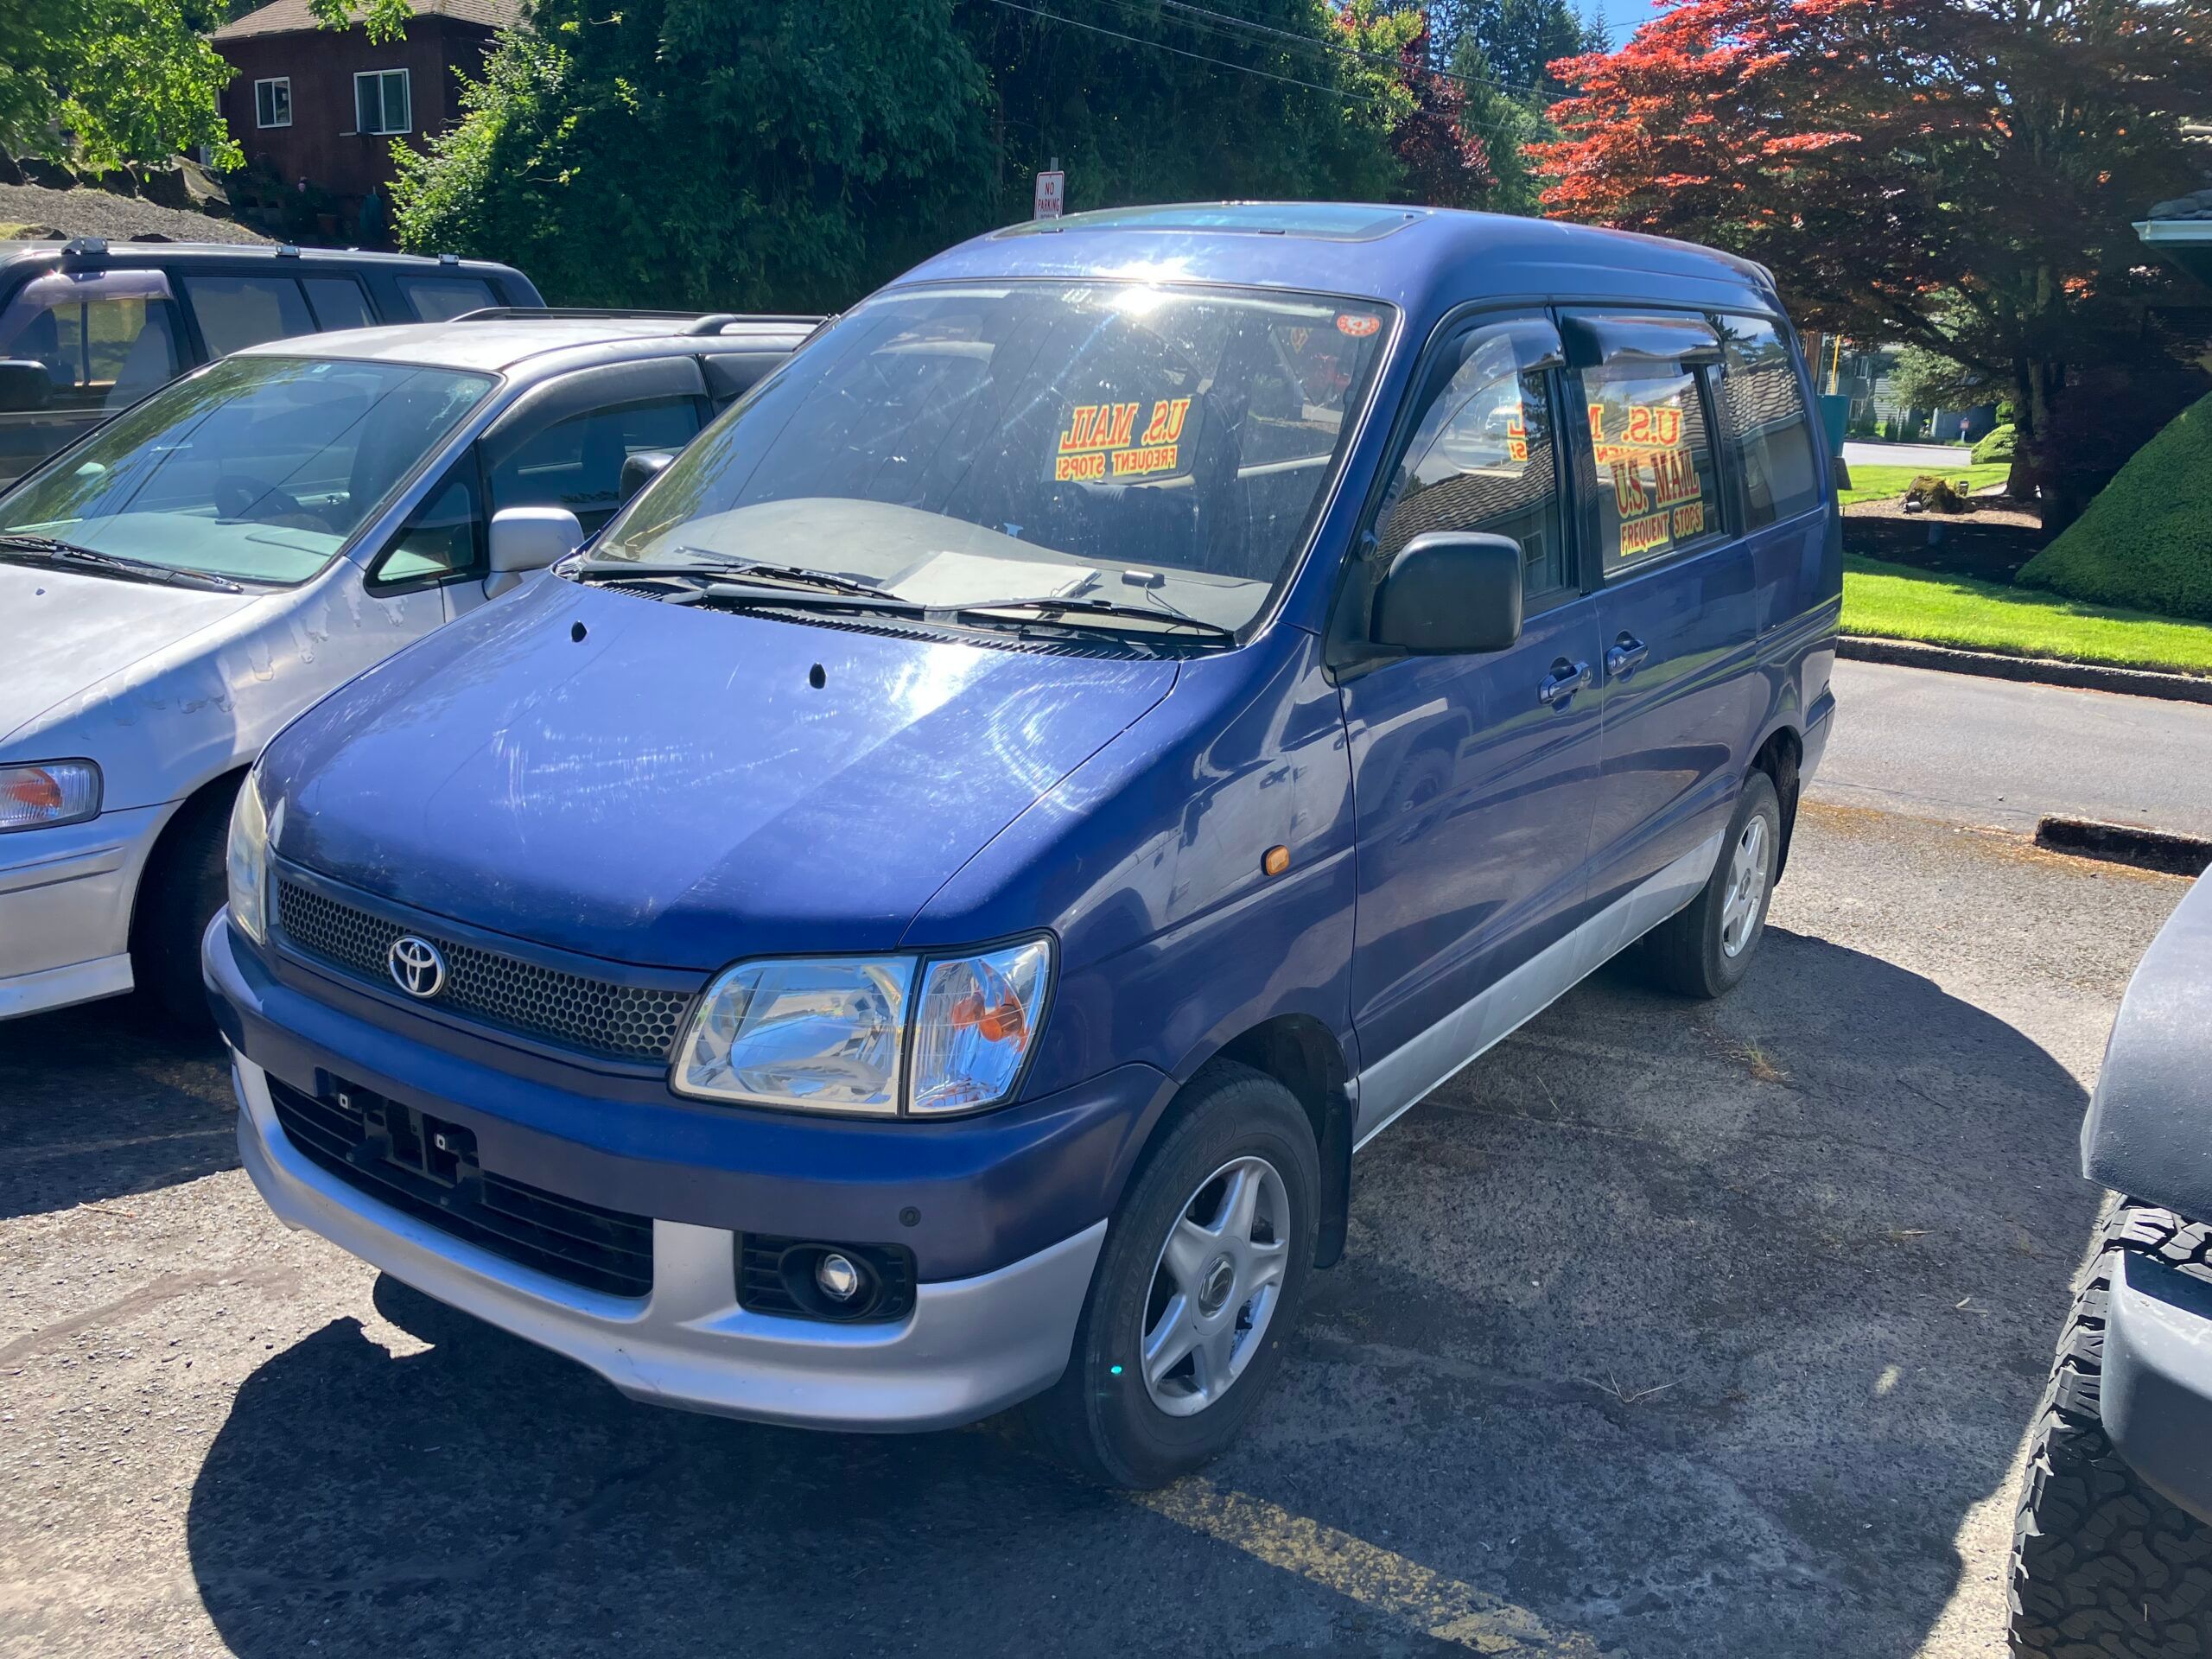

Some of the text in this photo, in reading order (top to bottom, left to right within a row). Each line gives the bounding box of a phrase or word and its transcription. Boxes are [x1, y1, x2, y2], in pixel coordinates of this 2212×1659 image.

[1038, 198, 1060, 212] PARKING
[1045, 181, 1054, 195] NO
[1611, 448, 1701, 517] U.S. MAIL
[1620, 501, 1703, 556] FREQUENT STOPS!
